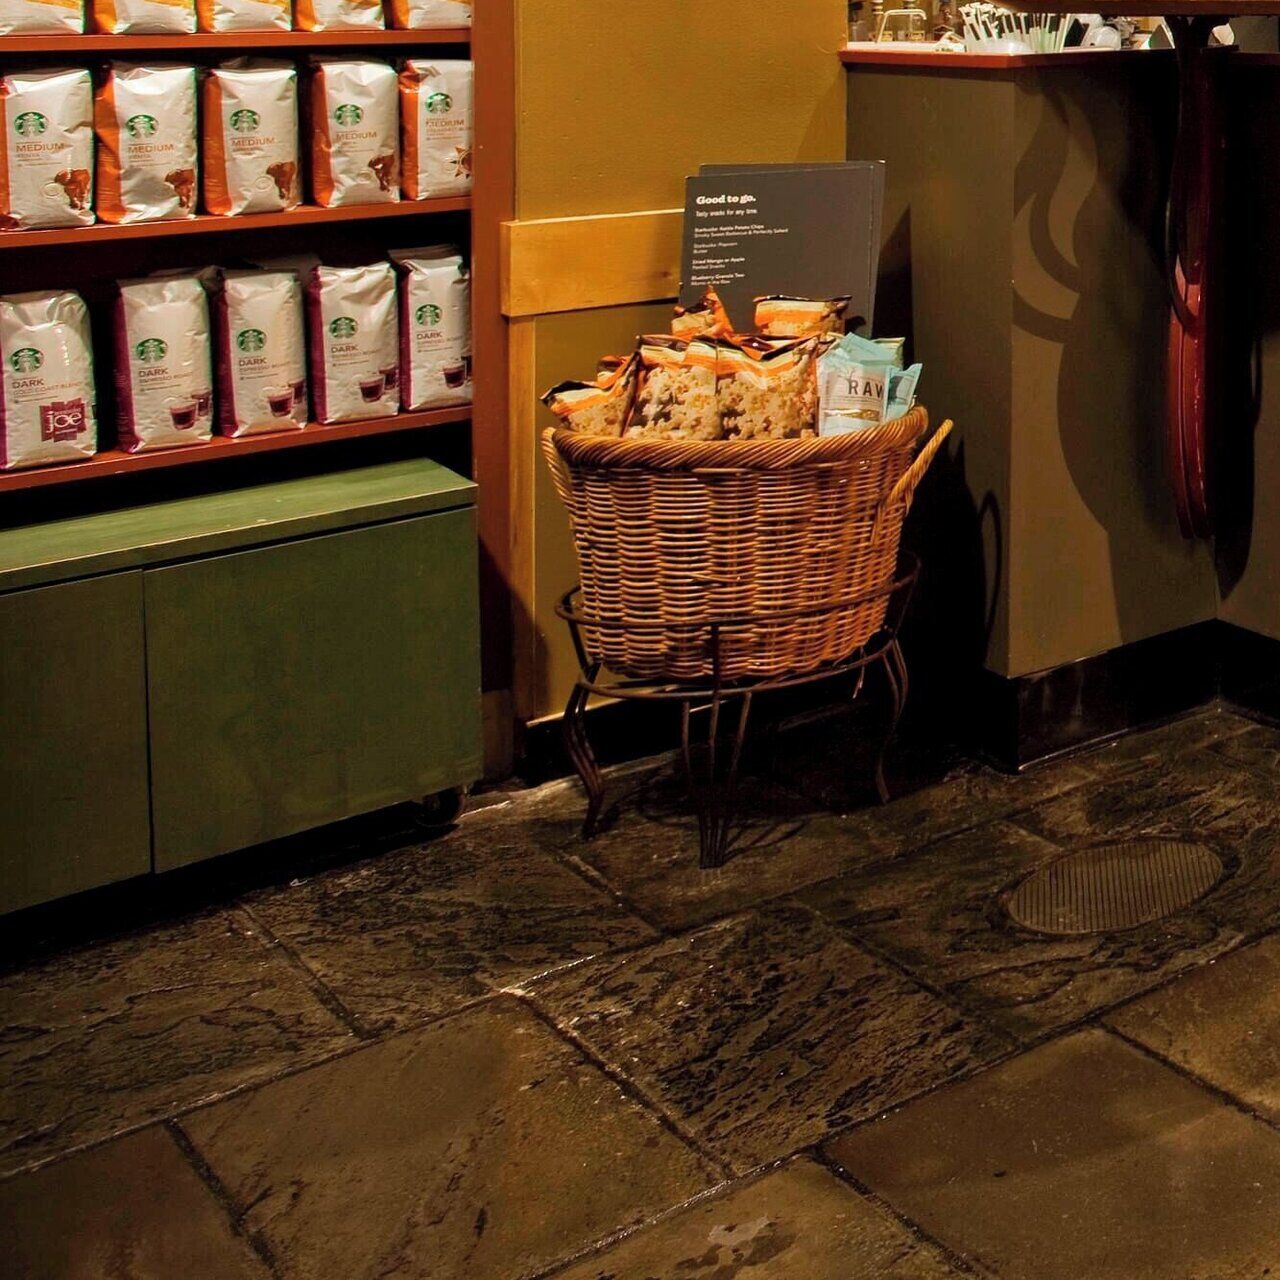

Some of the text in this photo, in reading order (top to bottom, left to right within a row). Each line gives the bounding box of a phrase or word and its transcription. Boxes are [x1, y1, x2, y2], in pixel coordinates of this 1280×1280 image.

[425, 119, 465, 127] MEDIUM
[336, 130, 378, 140] MEDIUM
[231, 136, 276, 146] MEDIUM
[16, 142, 65, 153] MEDIUM
[128, 143, 175, 153] MEDIUM
[696, 194, 757, 205] Good to go.
[417, 332, 443, 340] DARK
[331, 345, 359, 354] DARK
[239, 357, 267, 367] DARK
[139, 368, 169, 378] DARK
[12, 379, 45, 389] DARK
[46, 411, 82, 434] joe
